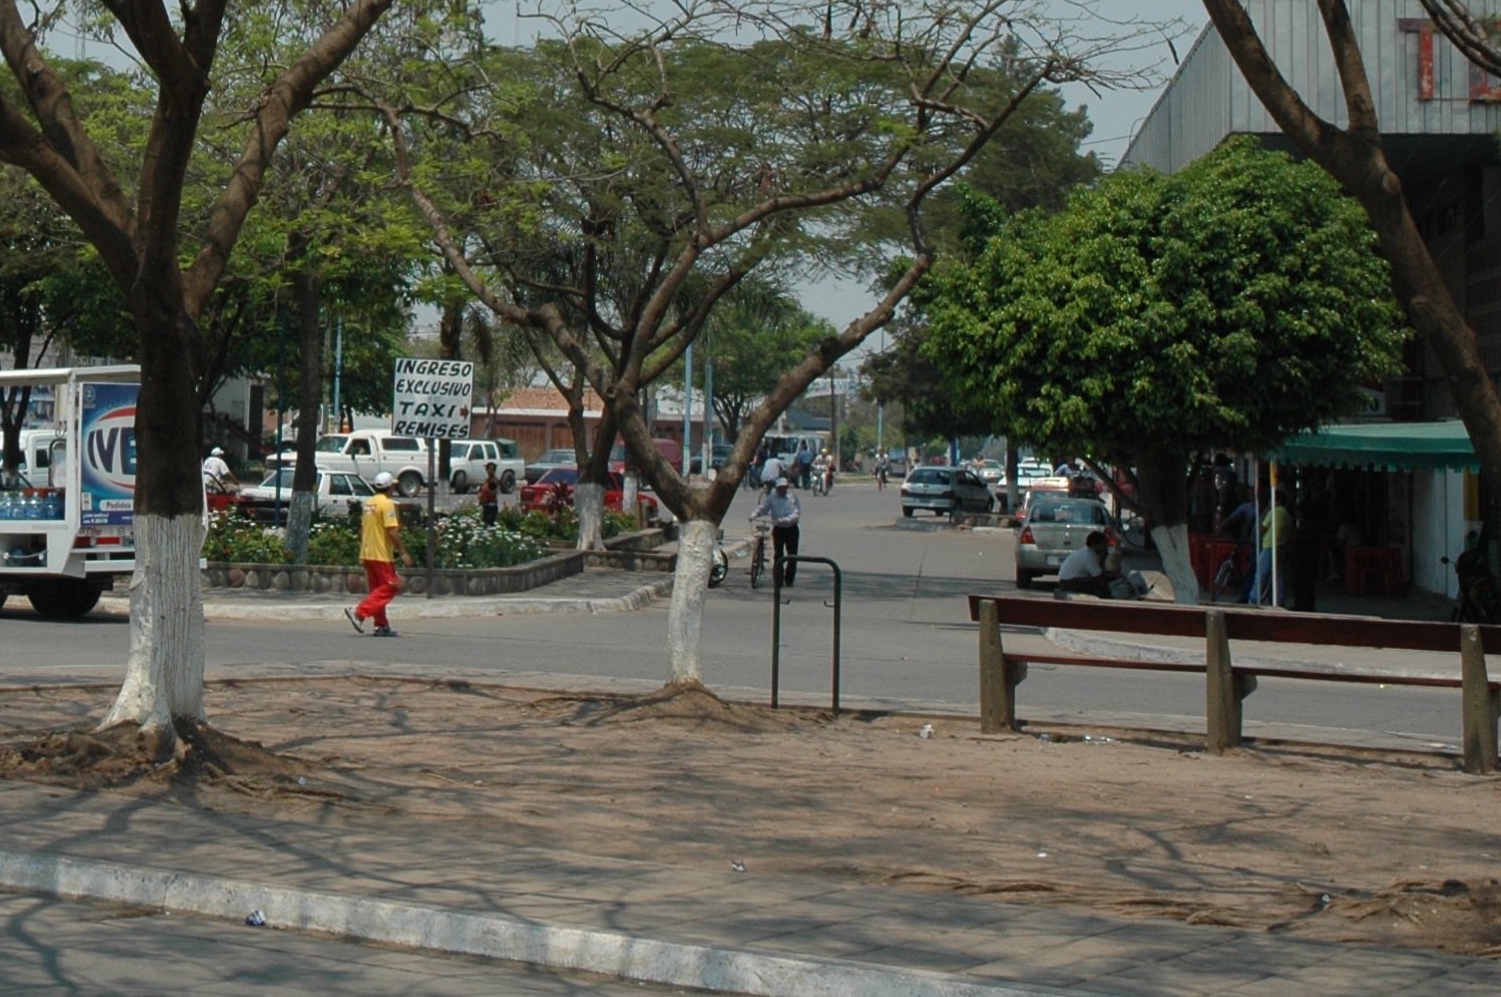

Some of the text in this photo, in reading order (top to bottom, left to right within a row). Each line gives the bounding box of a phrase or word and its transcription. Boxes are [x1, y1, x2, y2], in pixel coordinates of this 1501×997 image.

[396, 360, 472, 377] INGRESO
[396, 379, 471, 397] EXCLUSIVO
[399, 401, 456, 418] TAXI
[394, 421, 469, 438] REMISES
